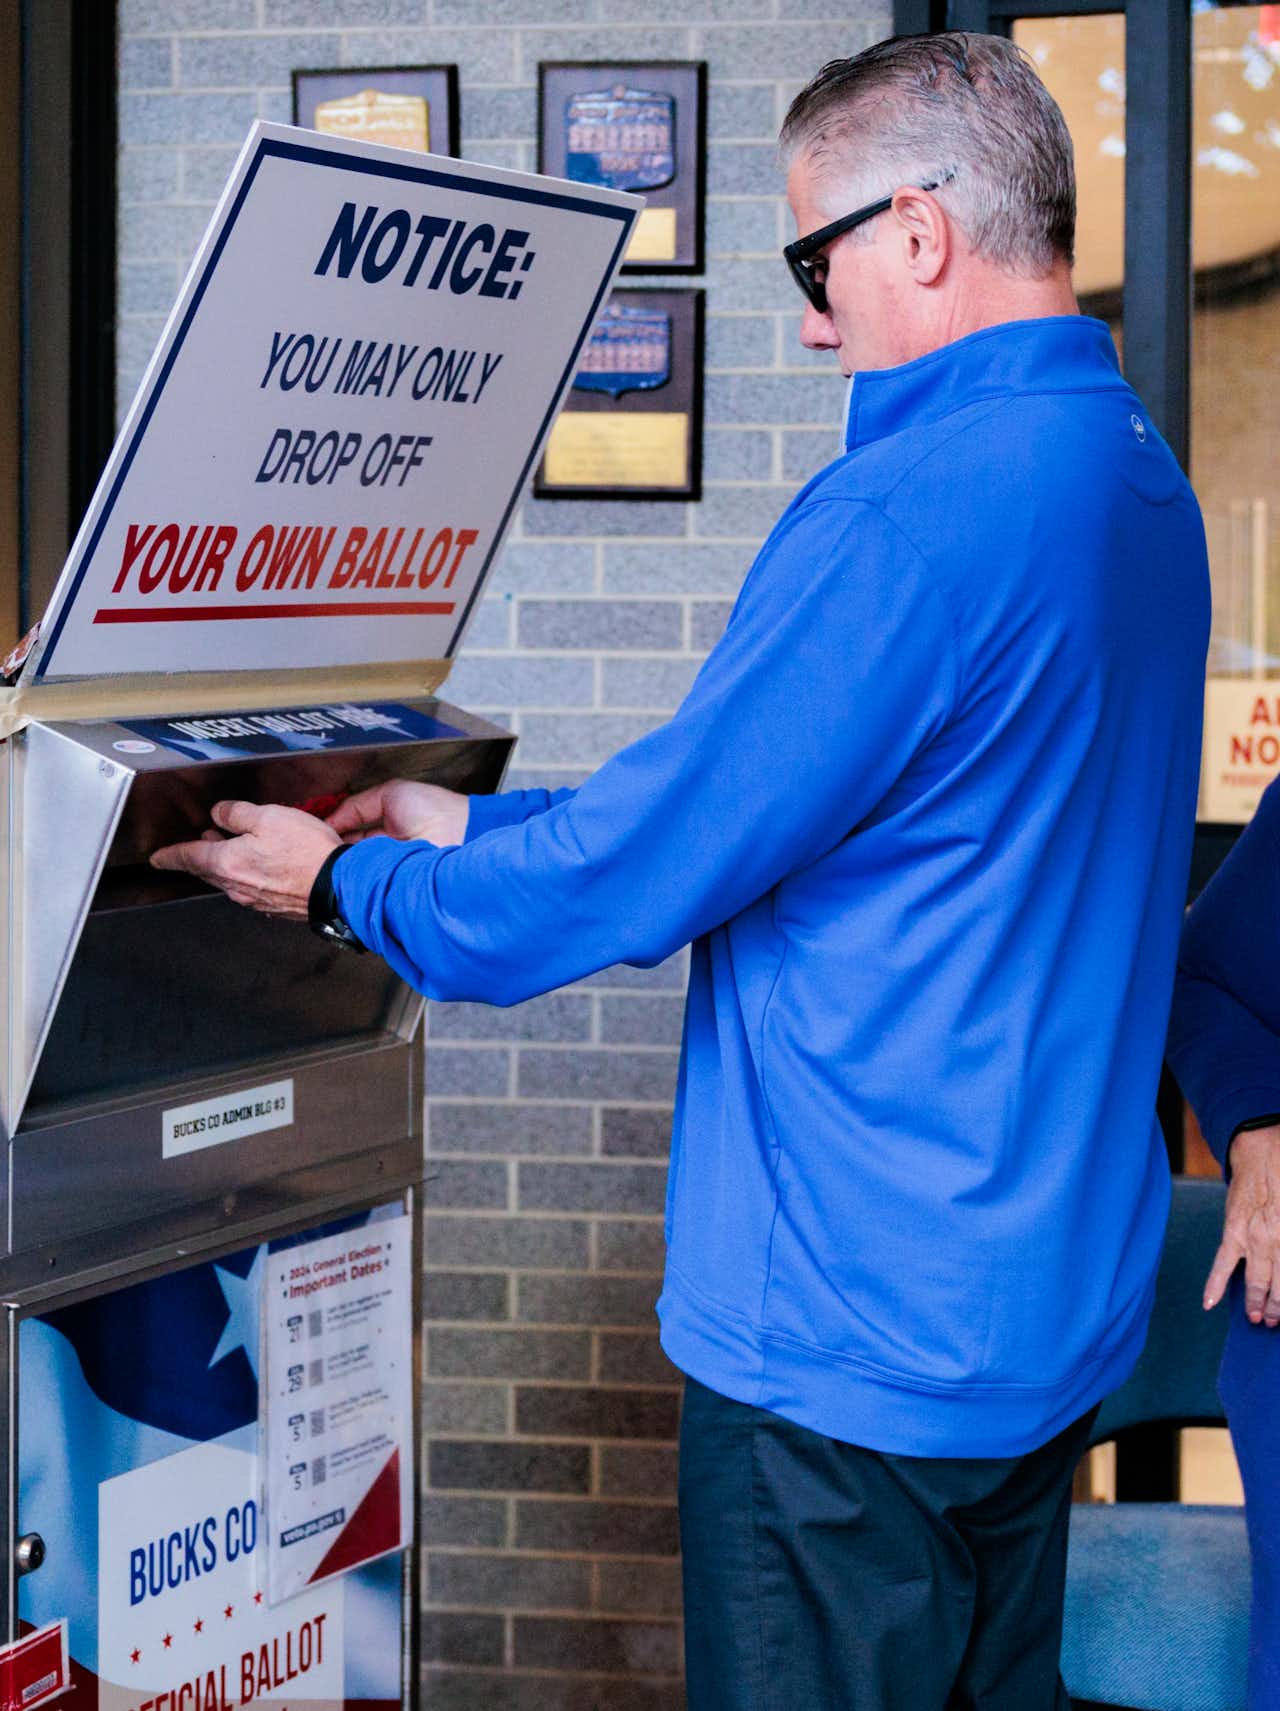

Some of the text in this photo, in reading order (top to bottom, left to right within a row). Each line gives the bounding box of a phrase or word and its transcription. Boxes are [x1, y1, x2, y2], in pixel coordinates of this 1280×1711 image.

[314, 202, 536, 300] NOTICE:
[260, 331, 503, 404] YOU MAY ONLY
[255, 428, 432, 487] DROP OFF
[112, 523, 479, 595] YOUR OWN BALLOT
[168, 717, 266, 740] INSERT
[250, 711, 345, 735] BALLOT
[1250, 697, 1280, 726] A
[173, 1096, 286, 1139] BUCKS CO ADMIN BLG #3
[289, 1260, 383, 1299] Important Dates
[313, 1252, 346, 1274] General
[129, 1515, 217, 1607] BUCKS
[240, 1613, 327, 1705] BALLOT
